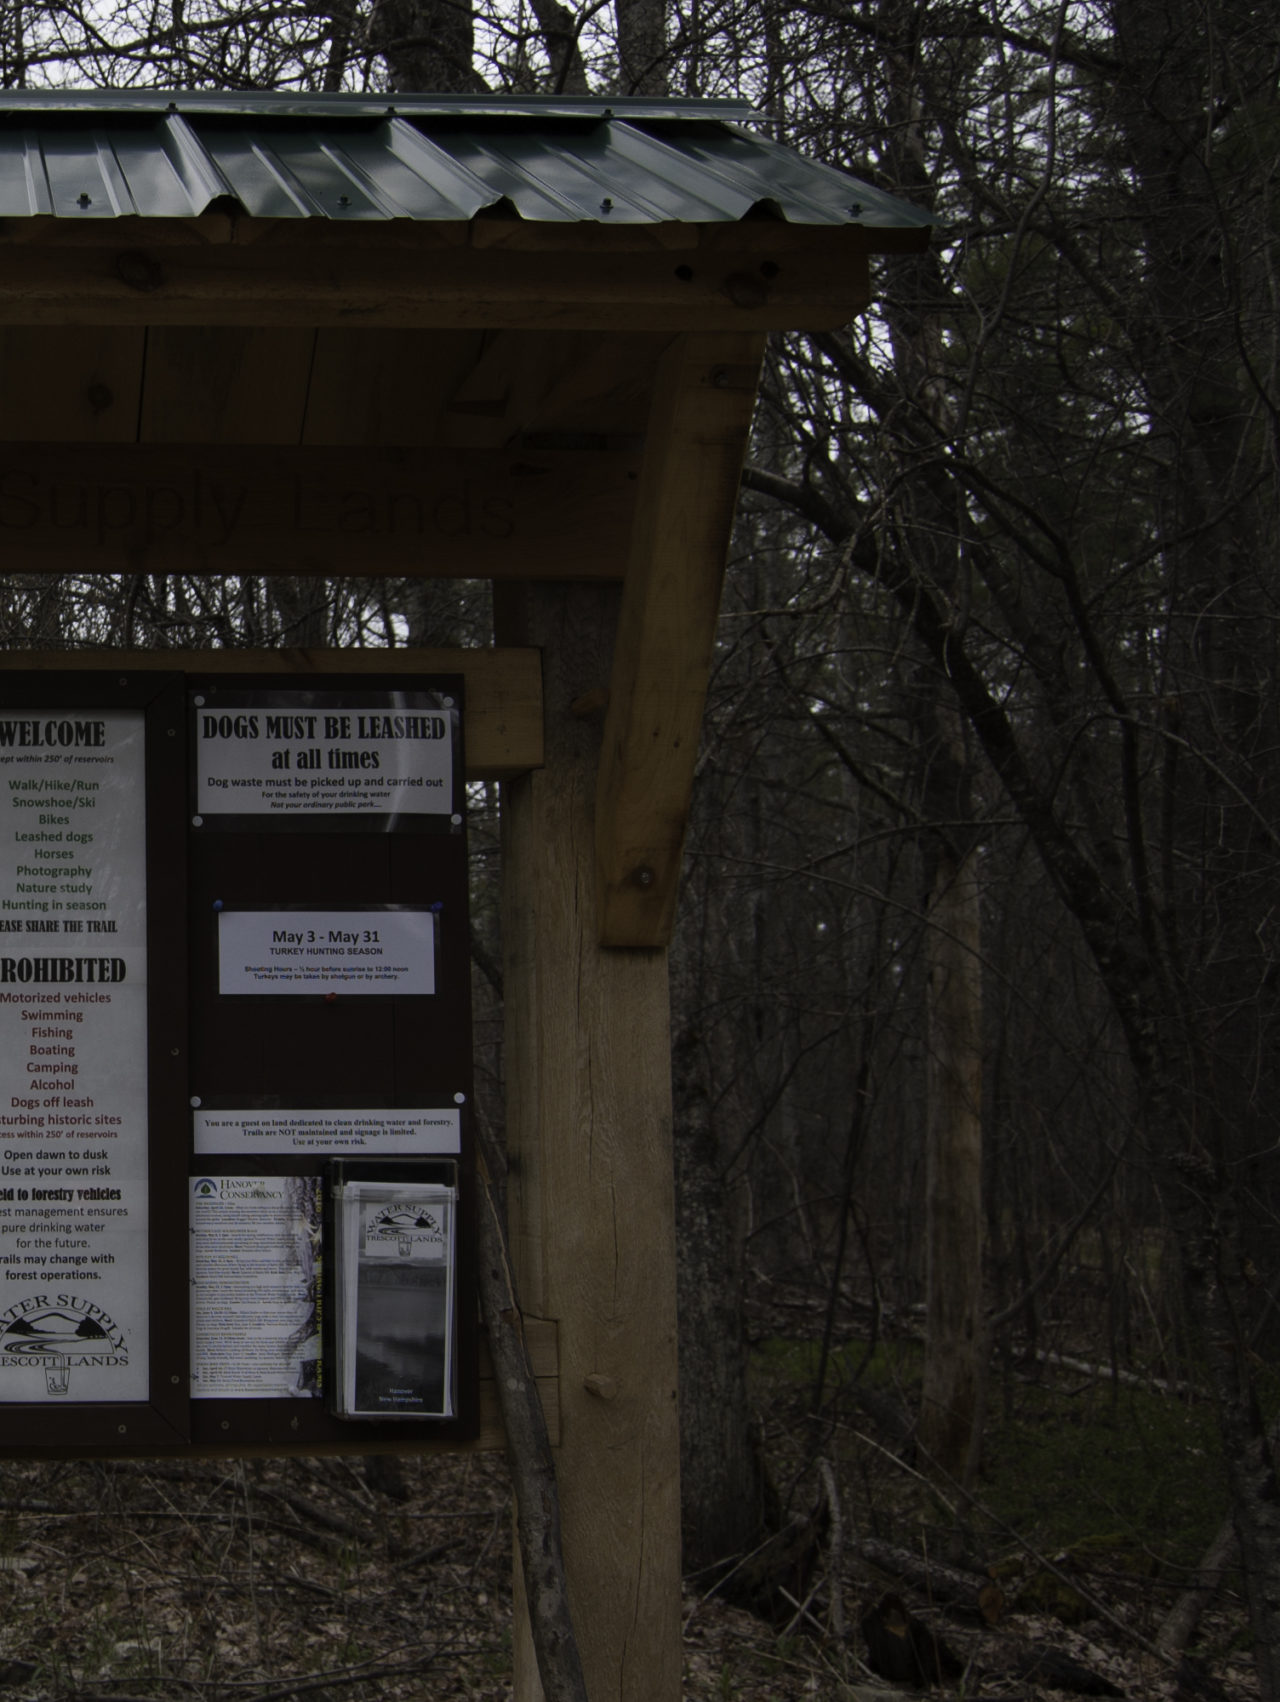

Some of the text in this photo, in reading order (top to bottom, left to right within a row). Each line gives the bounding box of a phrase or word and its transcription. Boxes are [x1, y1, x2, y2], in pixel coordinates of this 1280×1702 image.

[291, 470, 516, 539] Lands
[203, 715, 446, 740] DOGS MUST BE LEASHED
[16, 754, 43, 763] within
[44, 754, 62, 763] 250'
[63, 754, 74, 765] of
[74, 755, 114, 763] reservoirs
[272, 748, 380, 769] at all times
[8, 779, 99, 792] Walk/Hike/Run
[208, 776, 443, 789] Dog waste must be picked up and carried out
[12, 796, 95, 809] Snowshoe/Ski
[39, 814, 70, 825] Bikes
[15, 831, 93, 845] Leashed dogs
[34, 848, 74, 859] Horses
[17, 865, 92, 879] Photography
[16, 882, 93, 896] Nature study
[2, 899, 107, 913] Hunting in season
[26, 920, 59, 932] SHARE
[63, 920, 83, 933] THE
[86, 920, 118, 933] TRAIL
[273, 930, 303, 946] May
[307, 930, 315, 943] 3
[328, 931, 359, 946] May
[363, 930, 380, 943] 31
[270, 947, 383, 955] TURKEY HUNTING SEASON
[0, 992, 111, 1003] Motorized vehicles
[21, 1009, 83, 1023] Swimming
[32, 1026, 73, 1040] Fishing
[30, 1044, 75, 1058] Boating
[26, 1062, 78, 1075] Camping
[30, 1079, 74, 1090] Alcohol
[11, 1096, 94, 1110] Dogs off leash
[48, 1114, 92, 1125] historic
[95, 1114, 122, 1125] sites
[17, 1130, 44, 1139] within
[45, 1130, 63, 1139] 250'
[65, 1130, 75, 1138] of
[76, 1130, 118, 1139] reservoirs
[4, 1149, 108, 1162] Open dawn to dusk
[1, 1165, 111, 1178] Use at your own risk
[17, 1188, 29, 1201] to
[31, 1187, 74, 1202] forestry
[77, 1187, 121, 1201] vehicles
[14, 1207, 85, 1219] management
[87, 1208, 128, 1217] ensures
[367, 1204, 443, 1236] WATER SUPPLY
[1, 1221, 105, 1235] pure drinking water
[16, 1237, 90, 1248] for the future.
[24, 1256, 47, 1266] may
[50, 1253, 88, 1266] change
[90, 1253, 115, 1264] with
[5, 1269, 101, 1282] forest operations.
[56, 1294, 129, 1354] SUPPLY
[67, 1356, 129, 1367] LANDS
